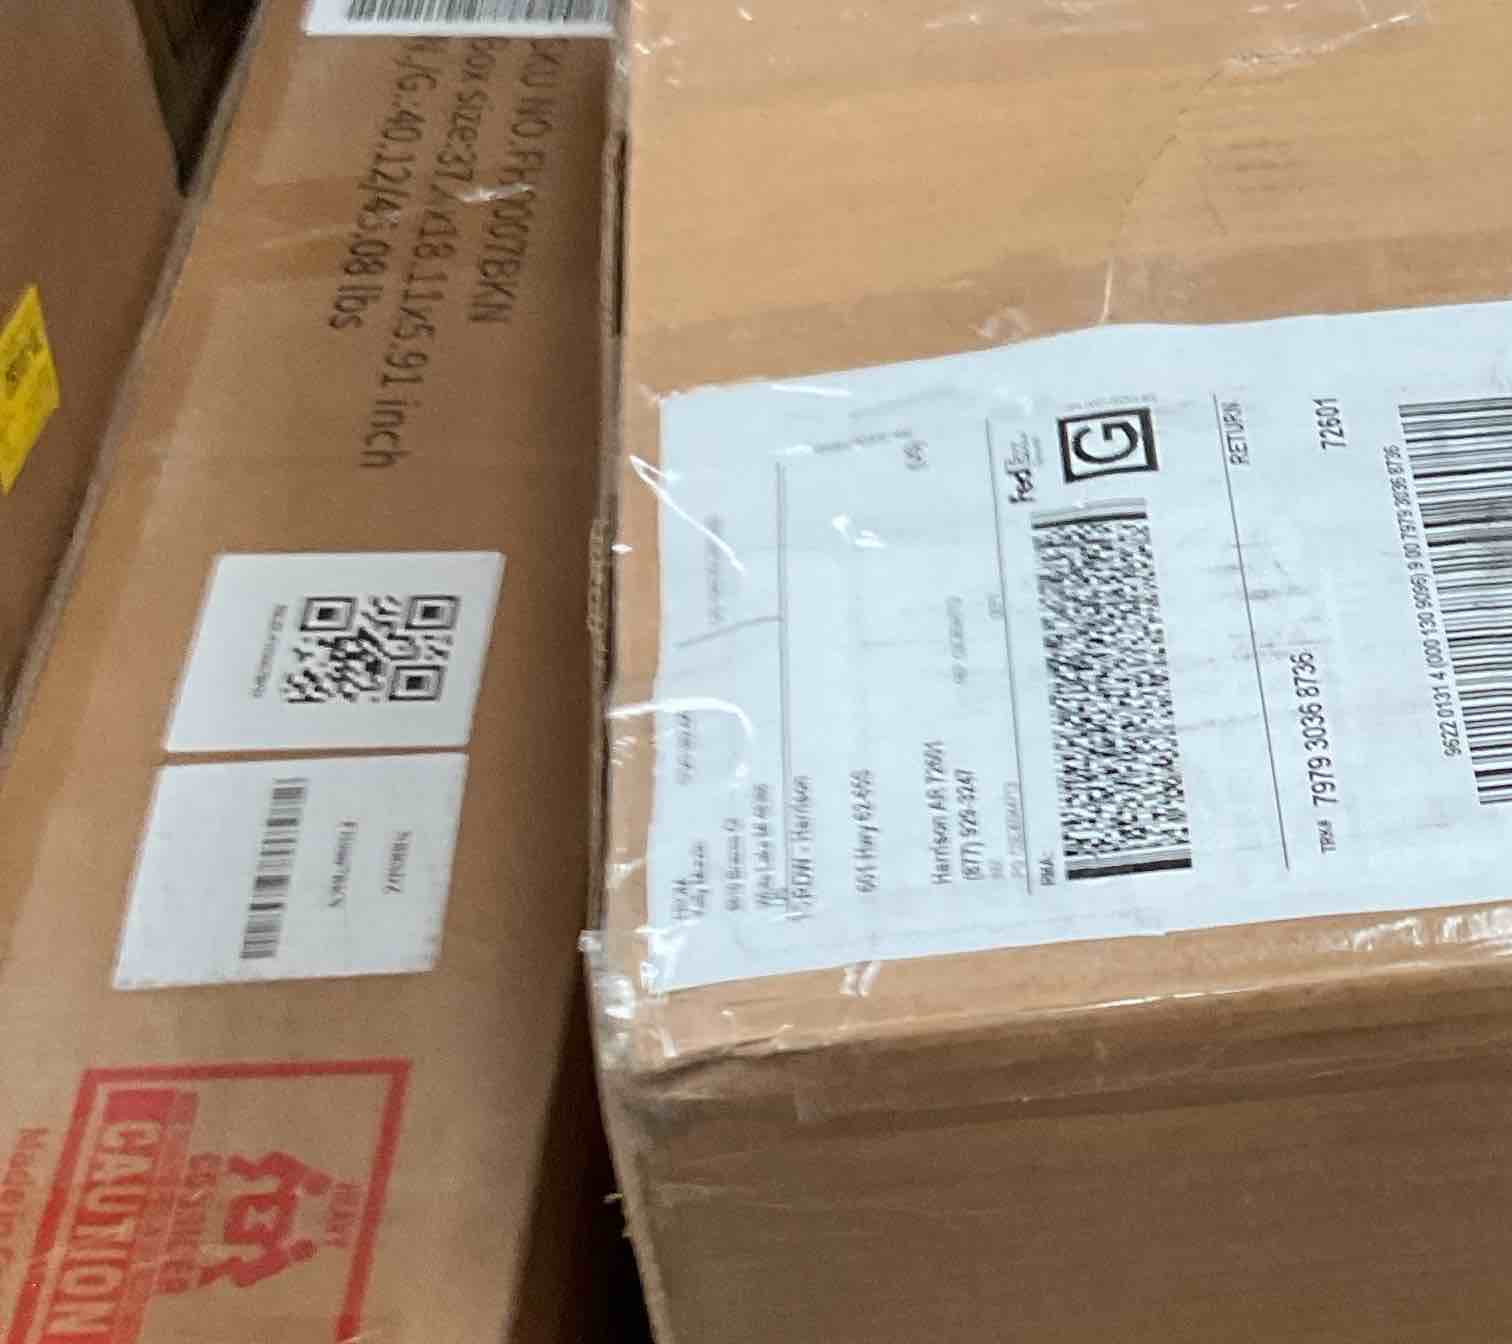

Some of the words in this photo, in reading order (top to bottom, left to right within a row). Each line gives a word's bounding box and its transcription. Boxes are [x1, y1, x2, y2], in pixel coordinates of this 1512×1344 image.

[328, 284, 385, 330] lbs
[359, 398, 420, 471] inch
[1071, 422, 1138, 464] G
[1221, 401, 1251, 465] RETURN
[1311, 396, 1348, 451] 72601
[1394, 510, 1419, 541] 7979
[1401, 542, 1422, 558] 00
[1405, 560, 1424, 570] 9
[1415, 611, 1439, 636] 130
[1289, 649, 1321, 698] 8736
[1421, 638, 1449, 668] (000
[1428, 670, 1447, 681] 4
[1433, 684, 1457, 723] 0131
[1297, 702, 1331, 752] 3036
[1440, 721, 1462, 756] 9622
[926, 786, 948, 811] AR
[1307, 755, 1340, 807] 7979
[929, 815, 952, 885] Harrison
[48, 1119, 166, 1336] CAUTION
